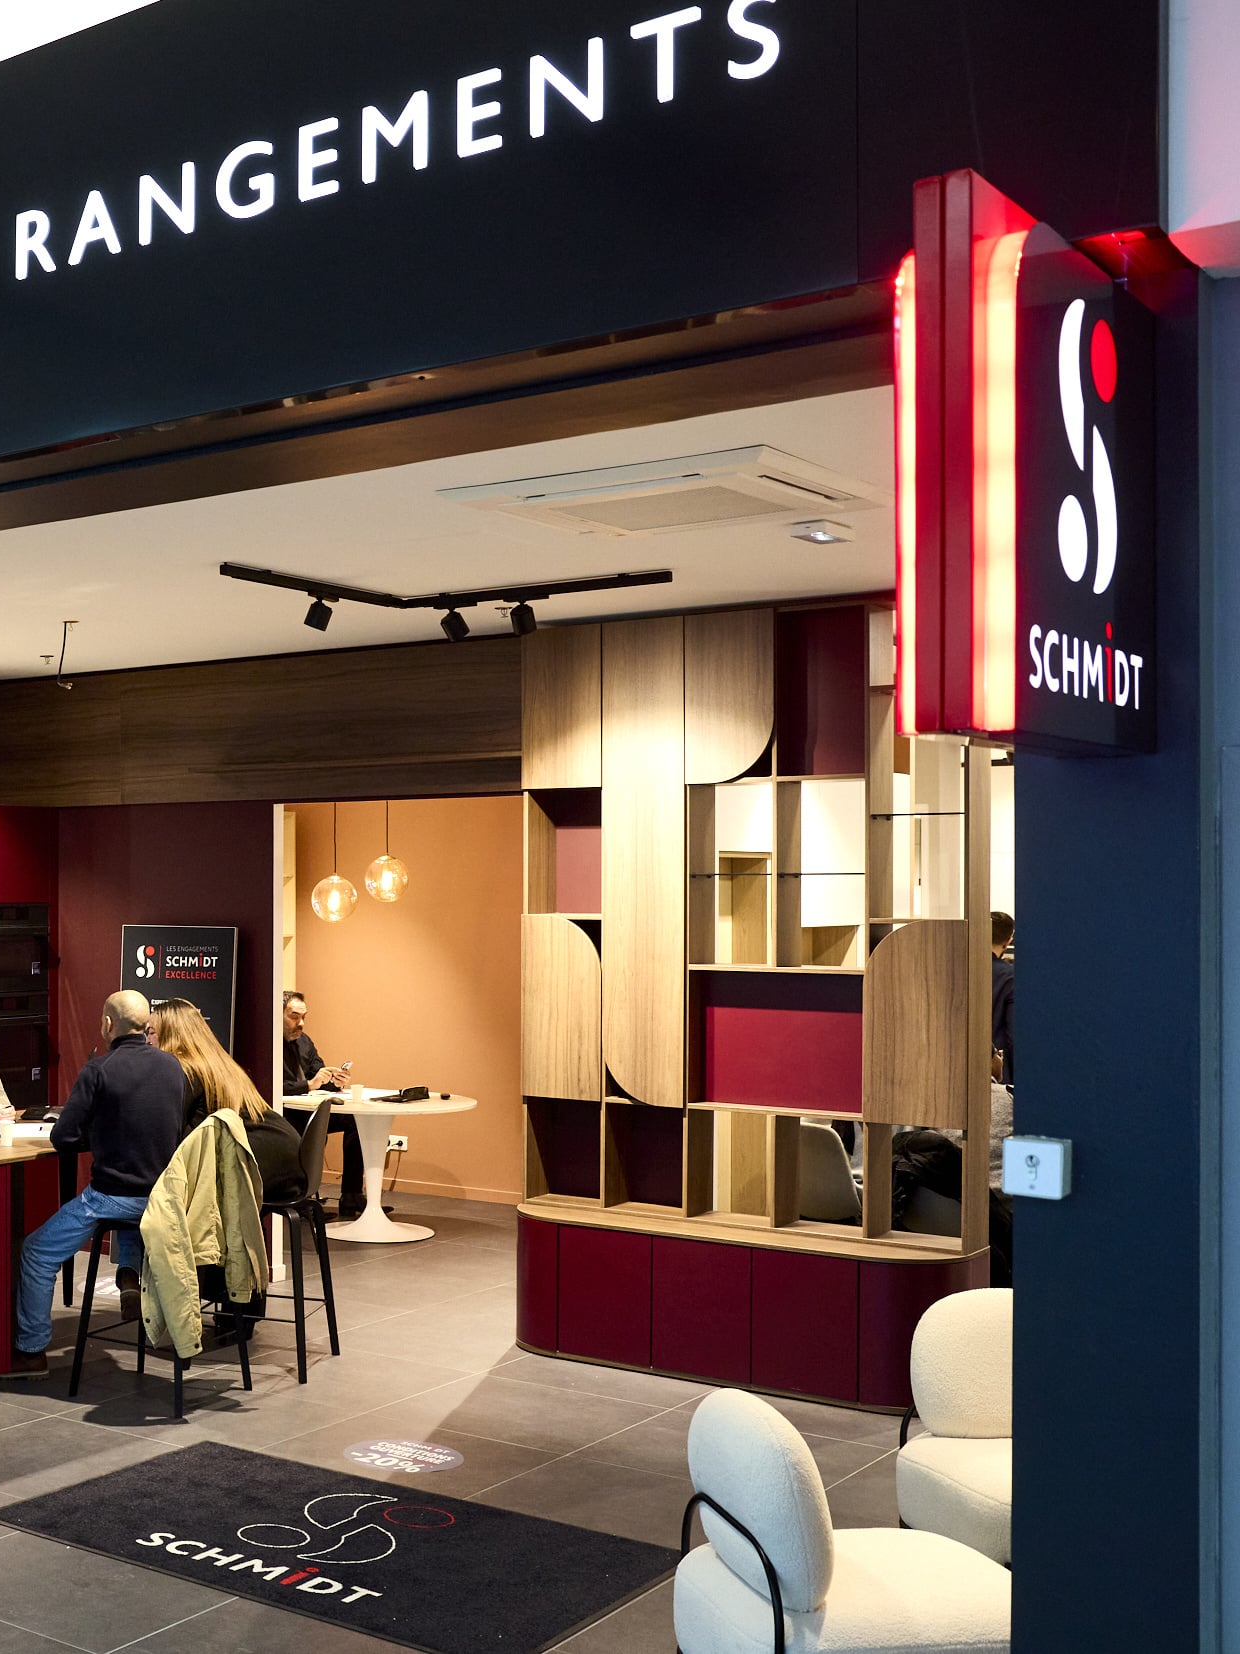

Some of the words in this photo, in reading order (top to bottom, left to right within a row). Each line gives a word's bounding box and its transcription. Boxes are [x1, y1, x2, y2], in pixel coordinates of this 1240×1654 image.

[15, 0, 781, 281] RANGEMENTS
[166, 945, 177, 953] LES
[177, 945, 219, 953] ENGAGEMENTS
[165, 970, 217, 980] EXCELLENCE
[369, 1444, 446, 1465] OUVERTURE
[377, 1441, 455, 1462] CONDITIONS
